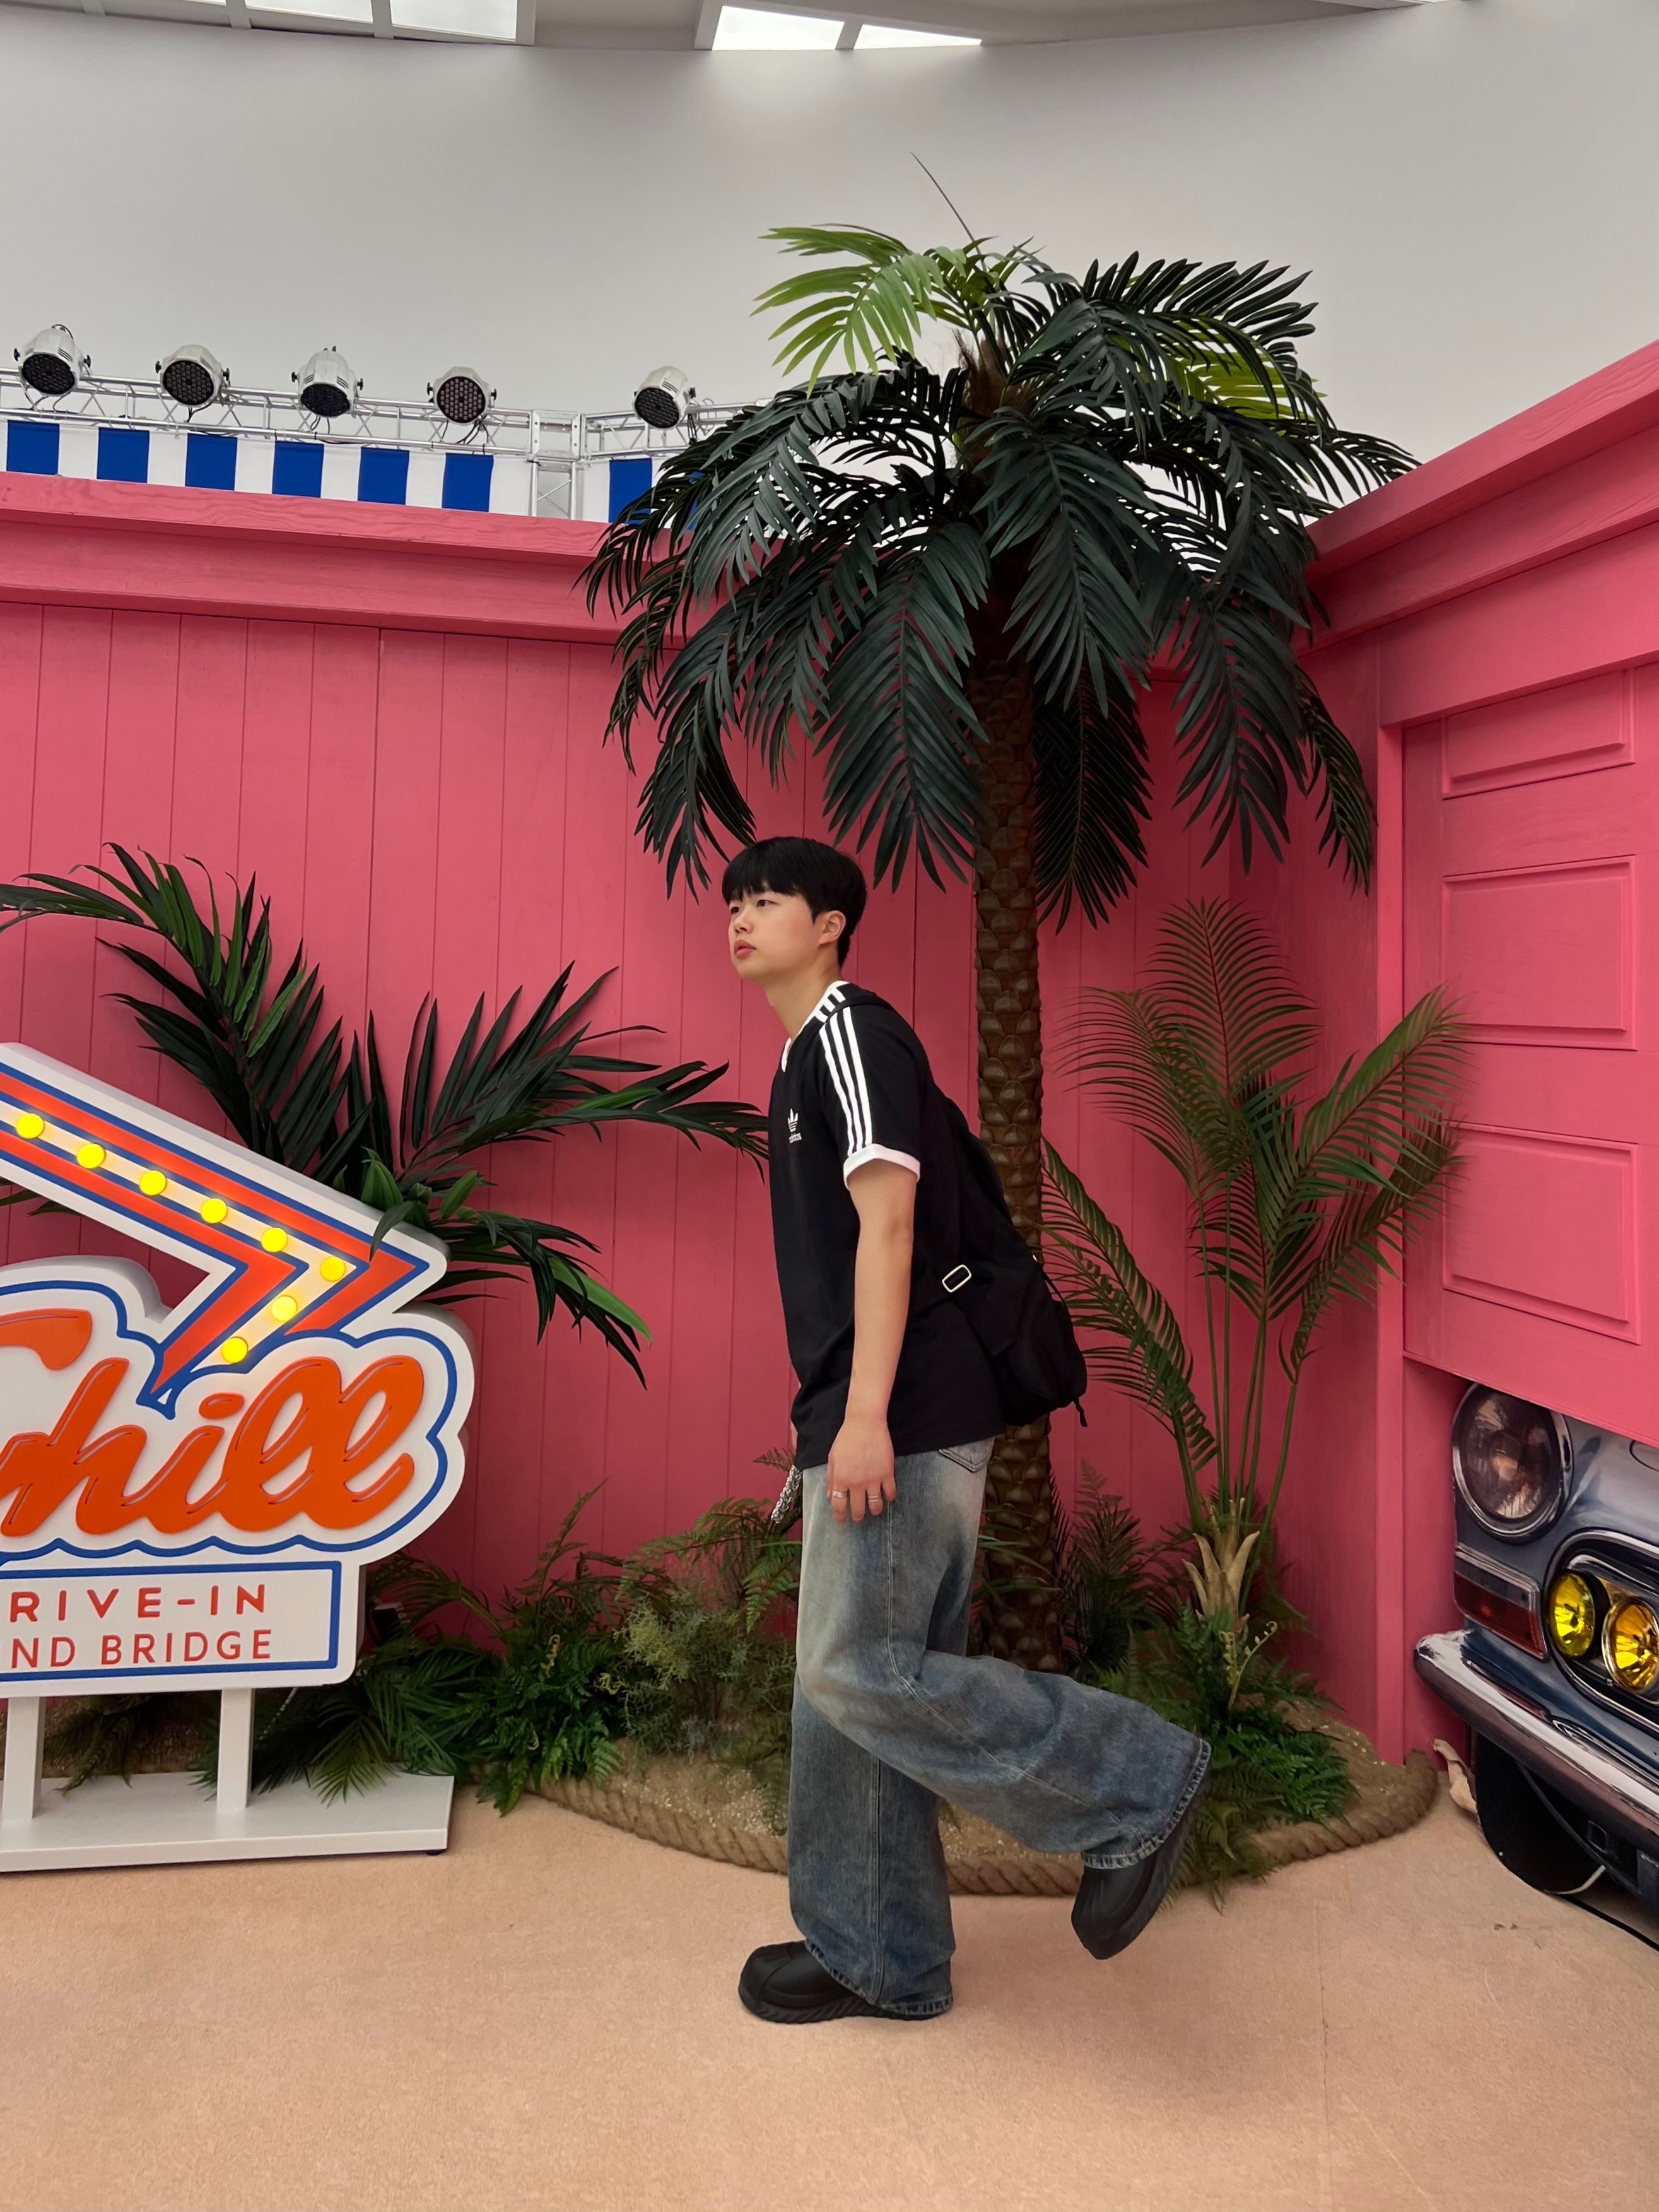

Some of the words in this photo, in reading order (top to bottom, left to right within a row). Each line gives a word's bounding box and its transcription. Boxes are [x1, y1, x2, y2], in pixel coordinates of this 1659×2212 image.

[9, 1584, 266, 1623] RIVE-IN
[11, 1637, 76, 1669] ND
[100, 1629, 271, 1666] BRIDGE
